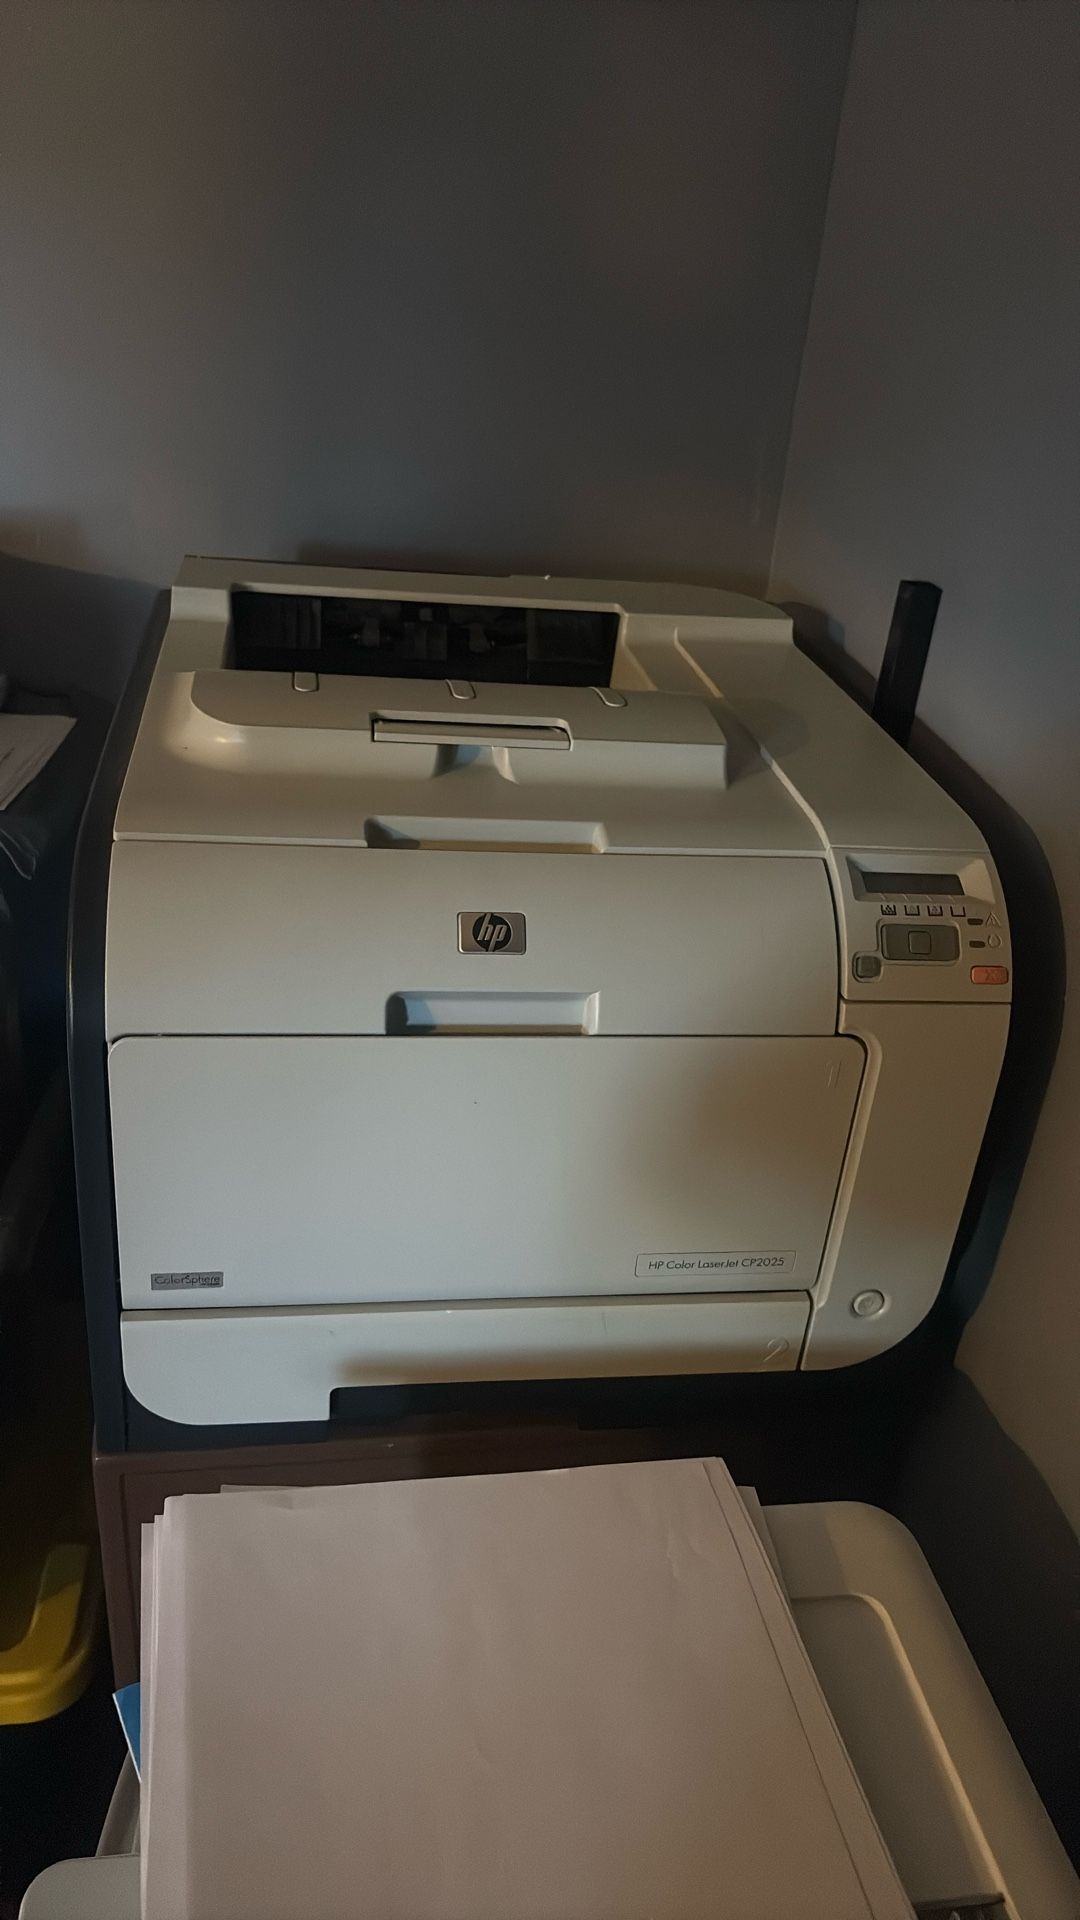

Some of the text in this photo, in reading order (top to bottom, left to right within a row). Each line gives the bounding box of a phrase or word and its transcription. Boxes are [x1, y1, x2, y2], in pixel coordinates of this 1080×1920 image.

[477, 913, 508, 952] hp
[648, 1257, 785, 1270] HP Color LaserJet CP2025
[154, 1275, 220, 1286] ColorSphere
